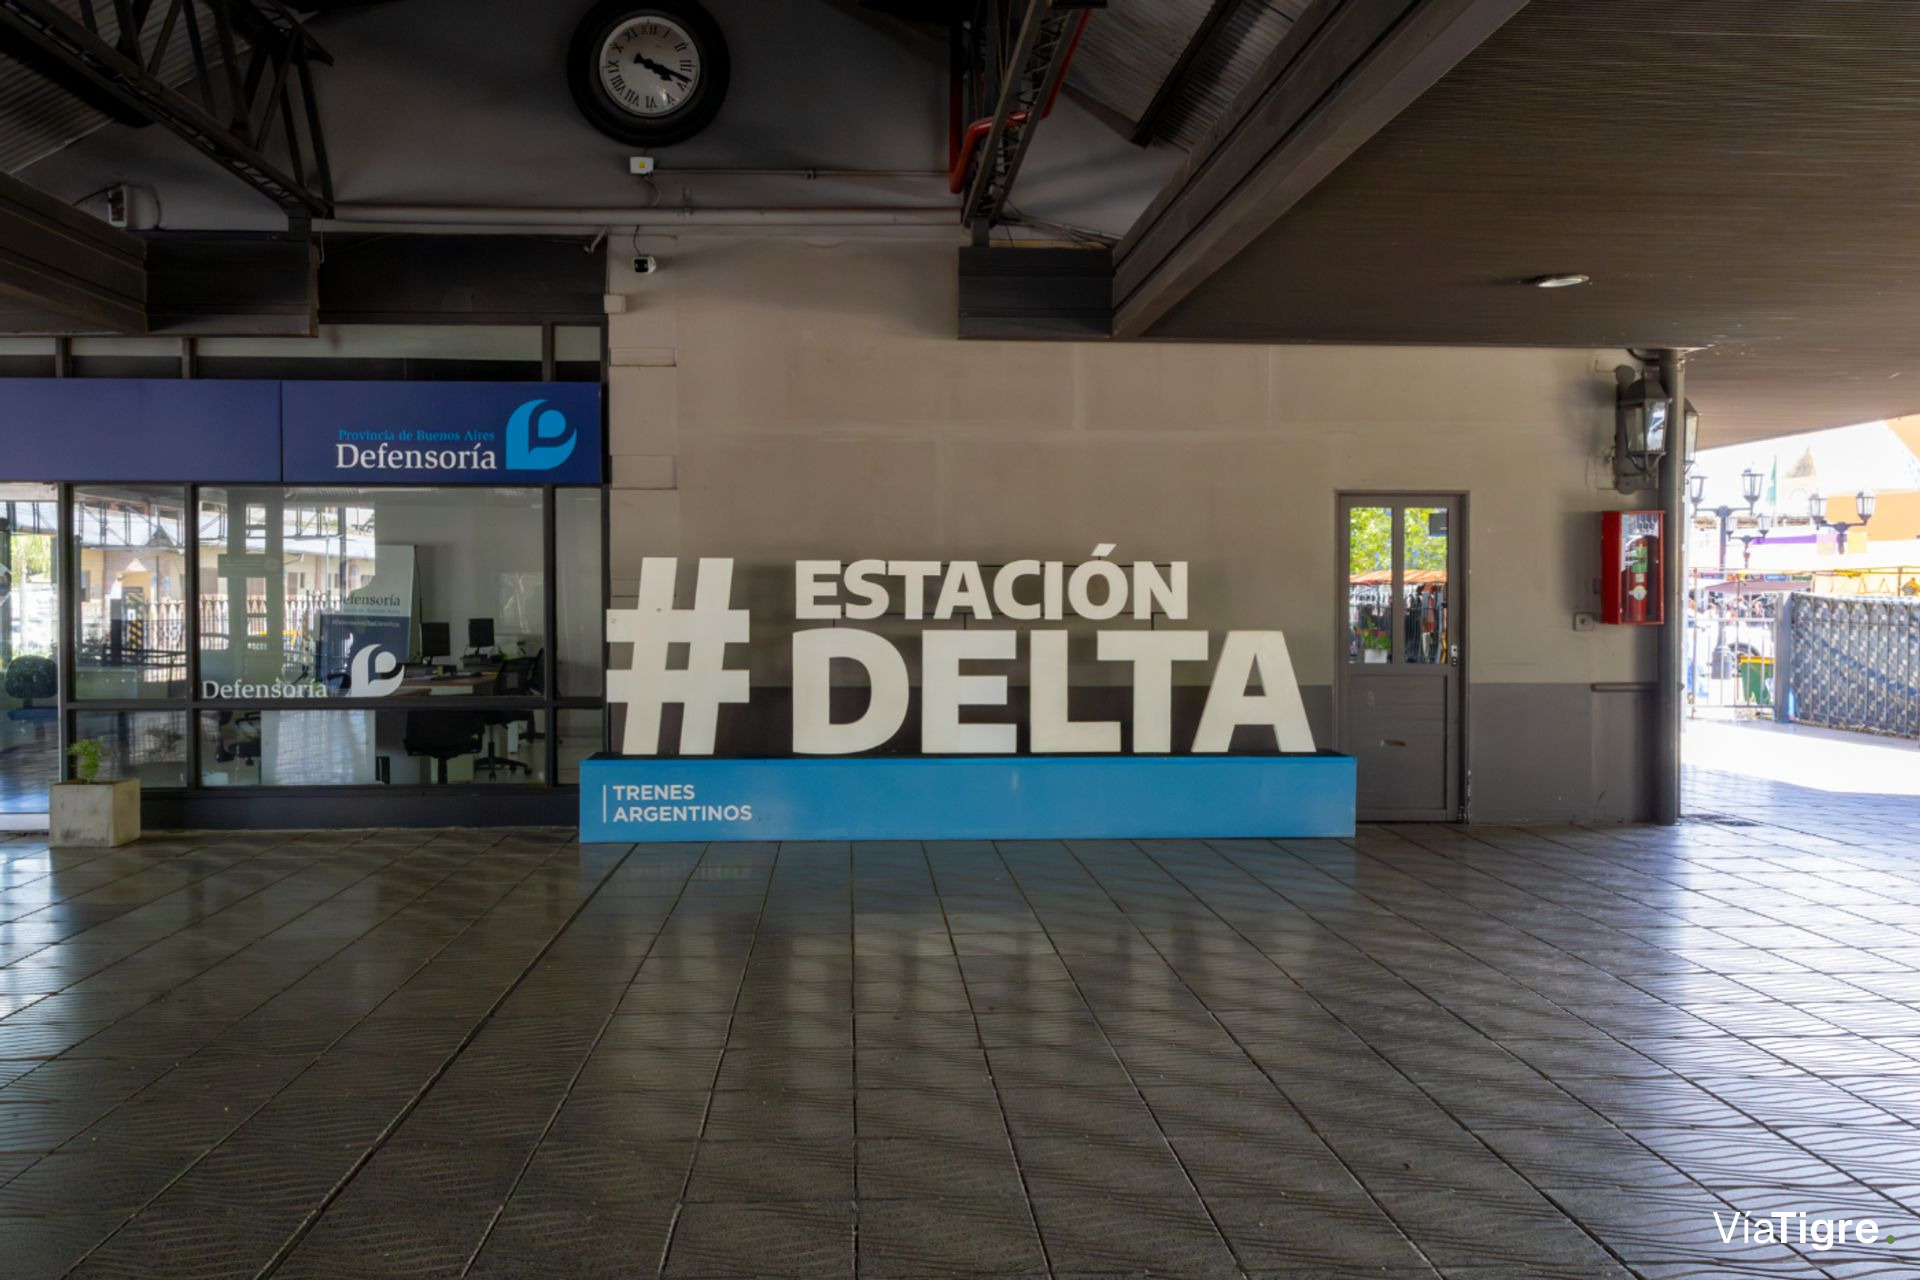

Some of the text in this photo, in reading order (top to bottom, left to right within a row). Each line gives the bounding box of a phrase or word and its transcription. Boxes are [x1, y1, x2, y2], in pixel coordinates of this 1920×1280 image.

[624, 27, 638, 42] XI
[640, 24, 657, 35] XII
[663, 28, 671, 39] I
[674, 42, 689, 52] II
[608, 60, 620, 74] IX
[680, 60, 692, 72] III
[646, 96, 657, 109] VI
[338, 429, 495, 441] Provincia de Buenos Aires
[336, 442, 498, 469] Defensoría
[795, 544, 1188, 620] ESTACIÓN
[202, 678, 329, 699] Defensoría
[792, 627, 1316, 754] DELTA
[612, 784, 695, 801] TRENES
[612, 805, 753, 823] ARGENTINOS
